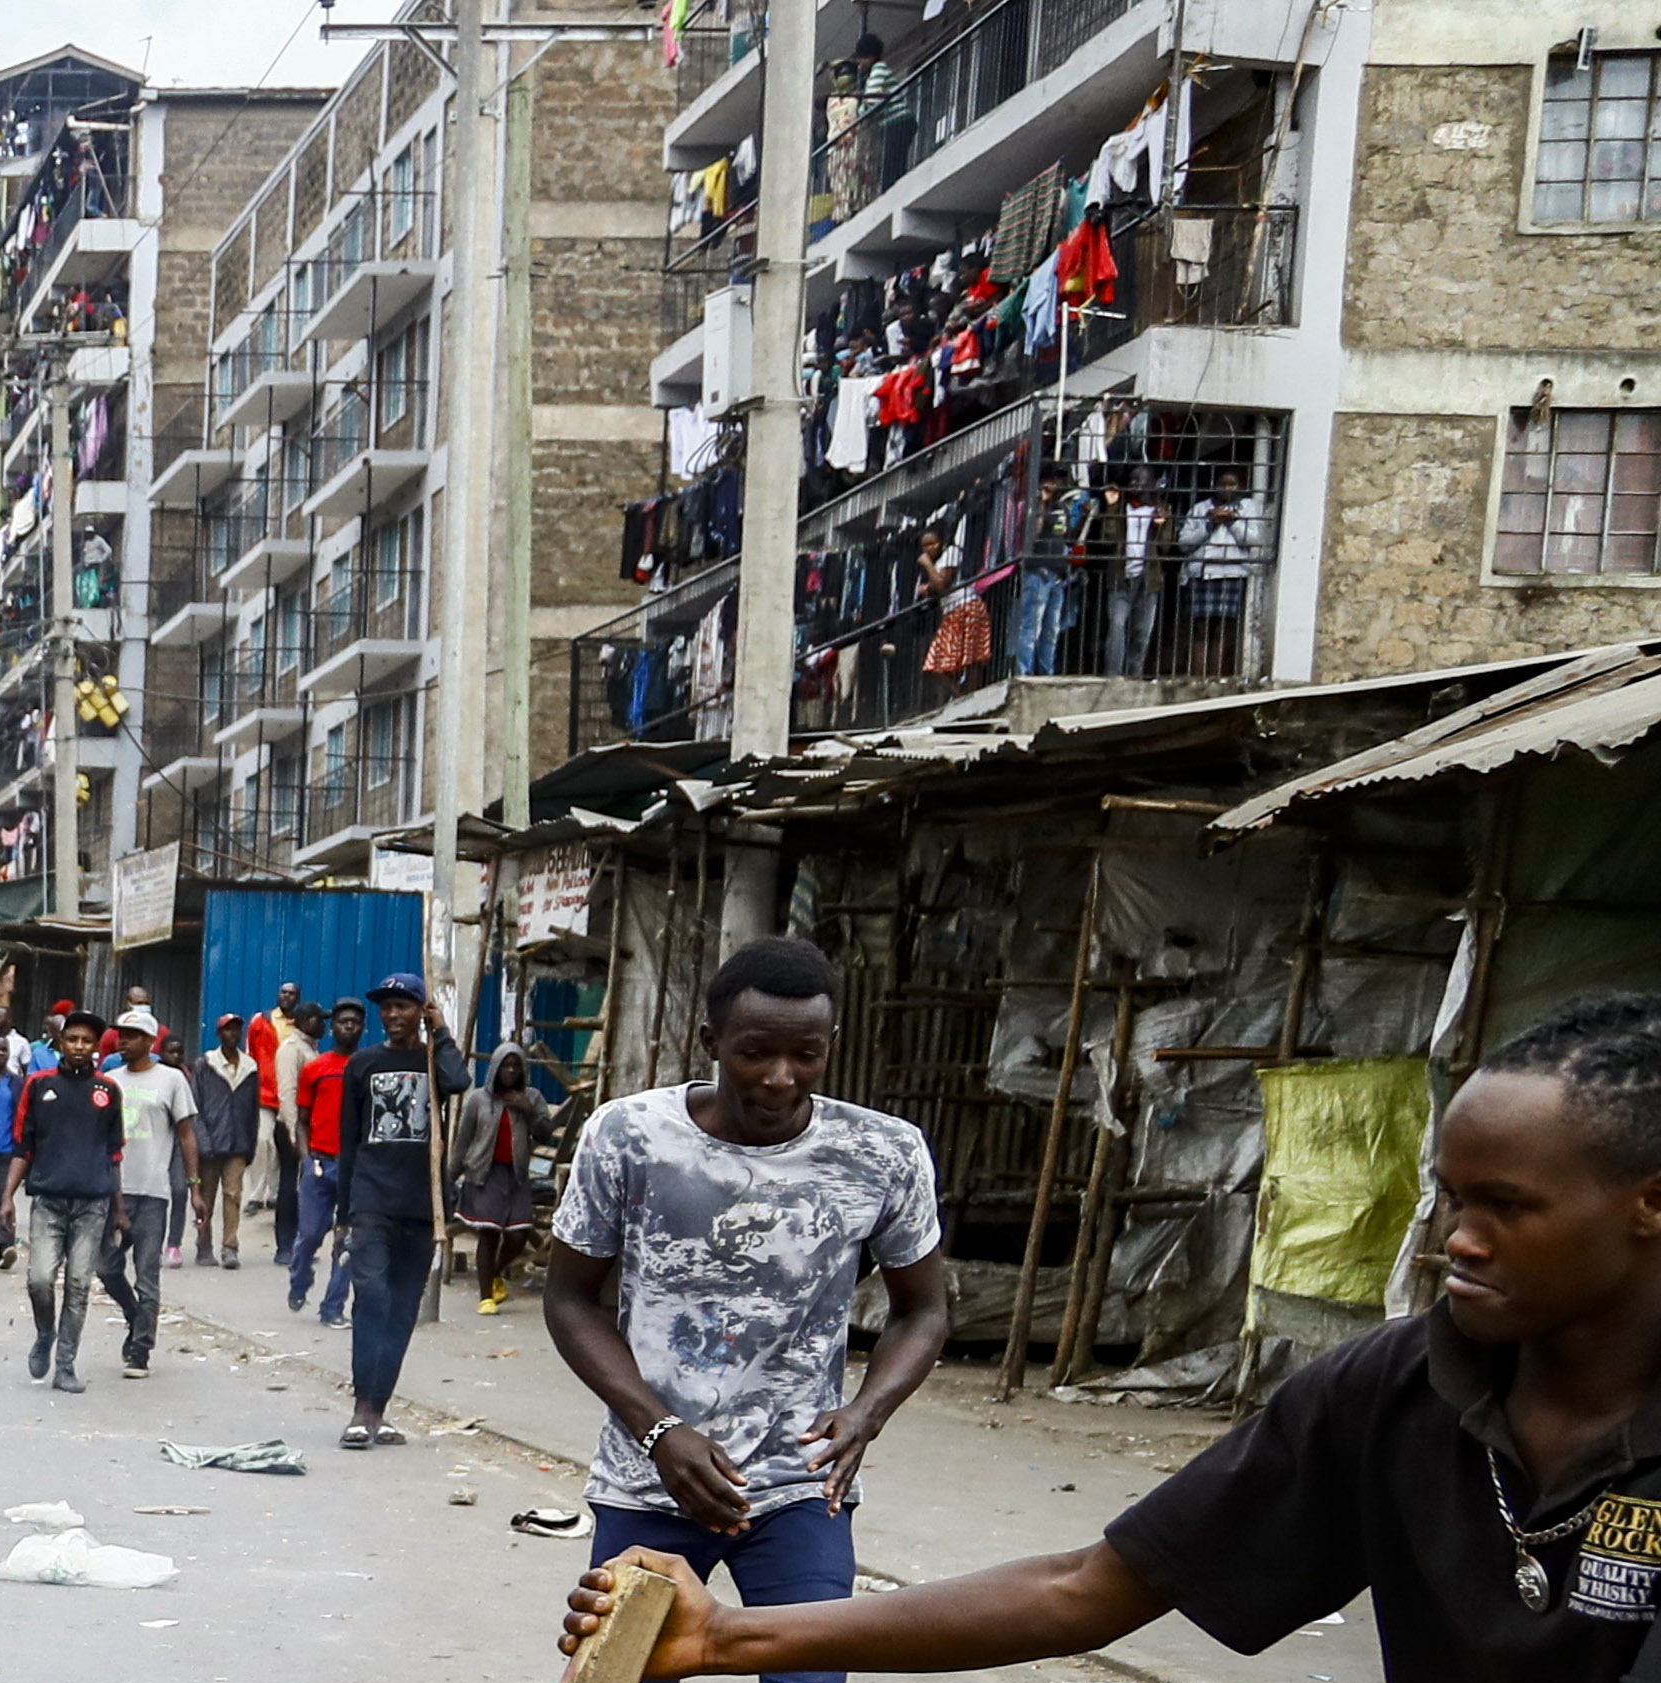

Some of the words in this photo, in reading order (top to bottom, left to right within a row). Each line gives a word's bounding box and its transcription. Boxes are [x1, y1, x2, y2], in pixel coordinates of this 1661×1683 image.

[1596, 1500, 1661, 1532] GLEN
[1586, 1521, 1661, 1554] ROCK
[1579, 1559, 1655, 1588] QUALITY
[1578, 1576, 1651, 1604] WHISKY
